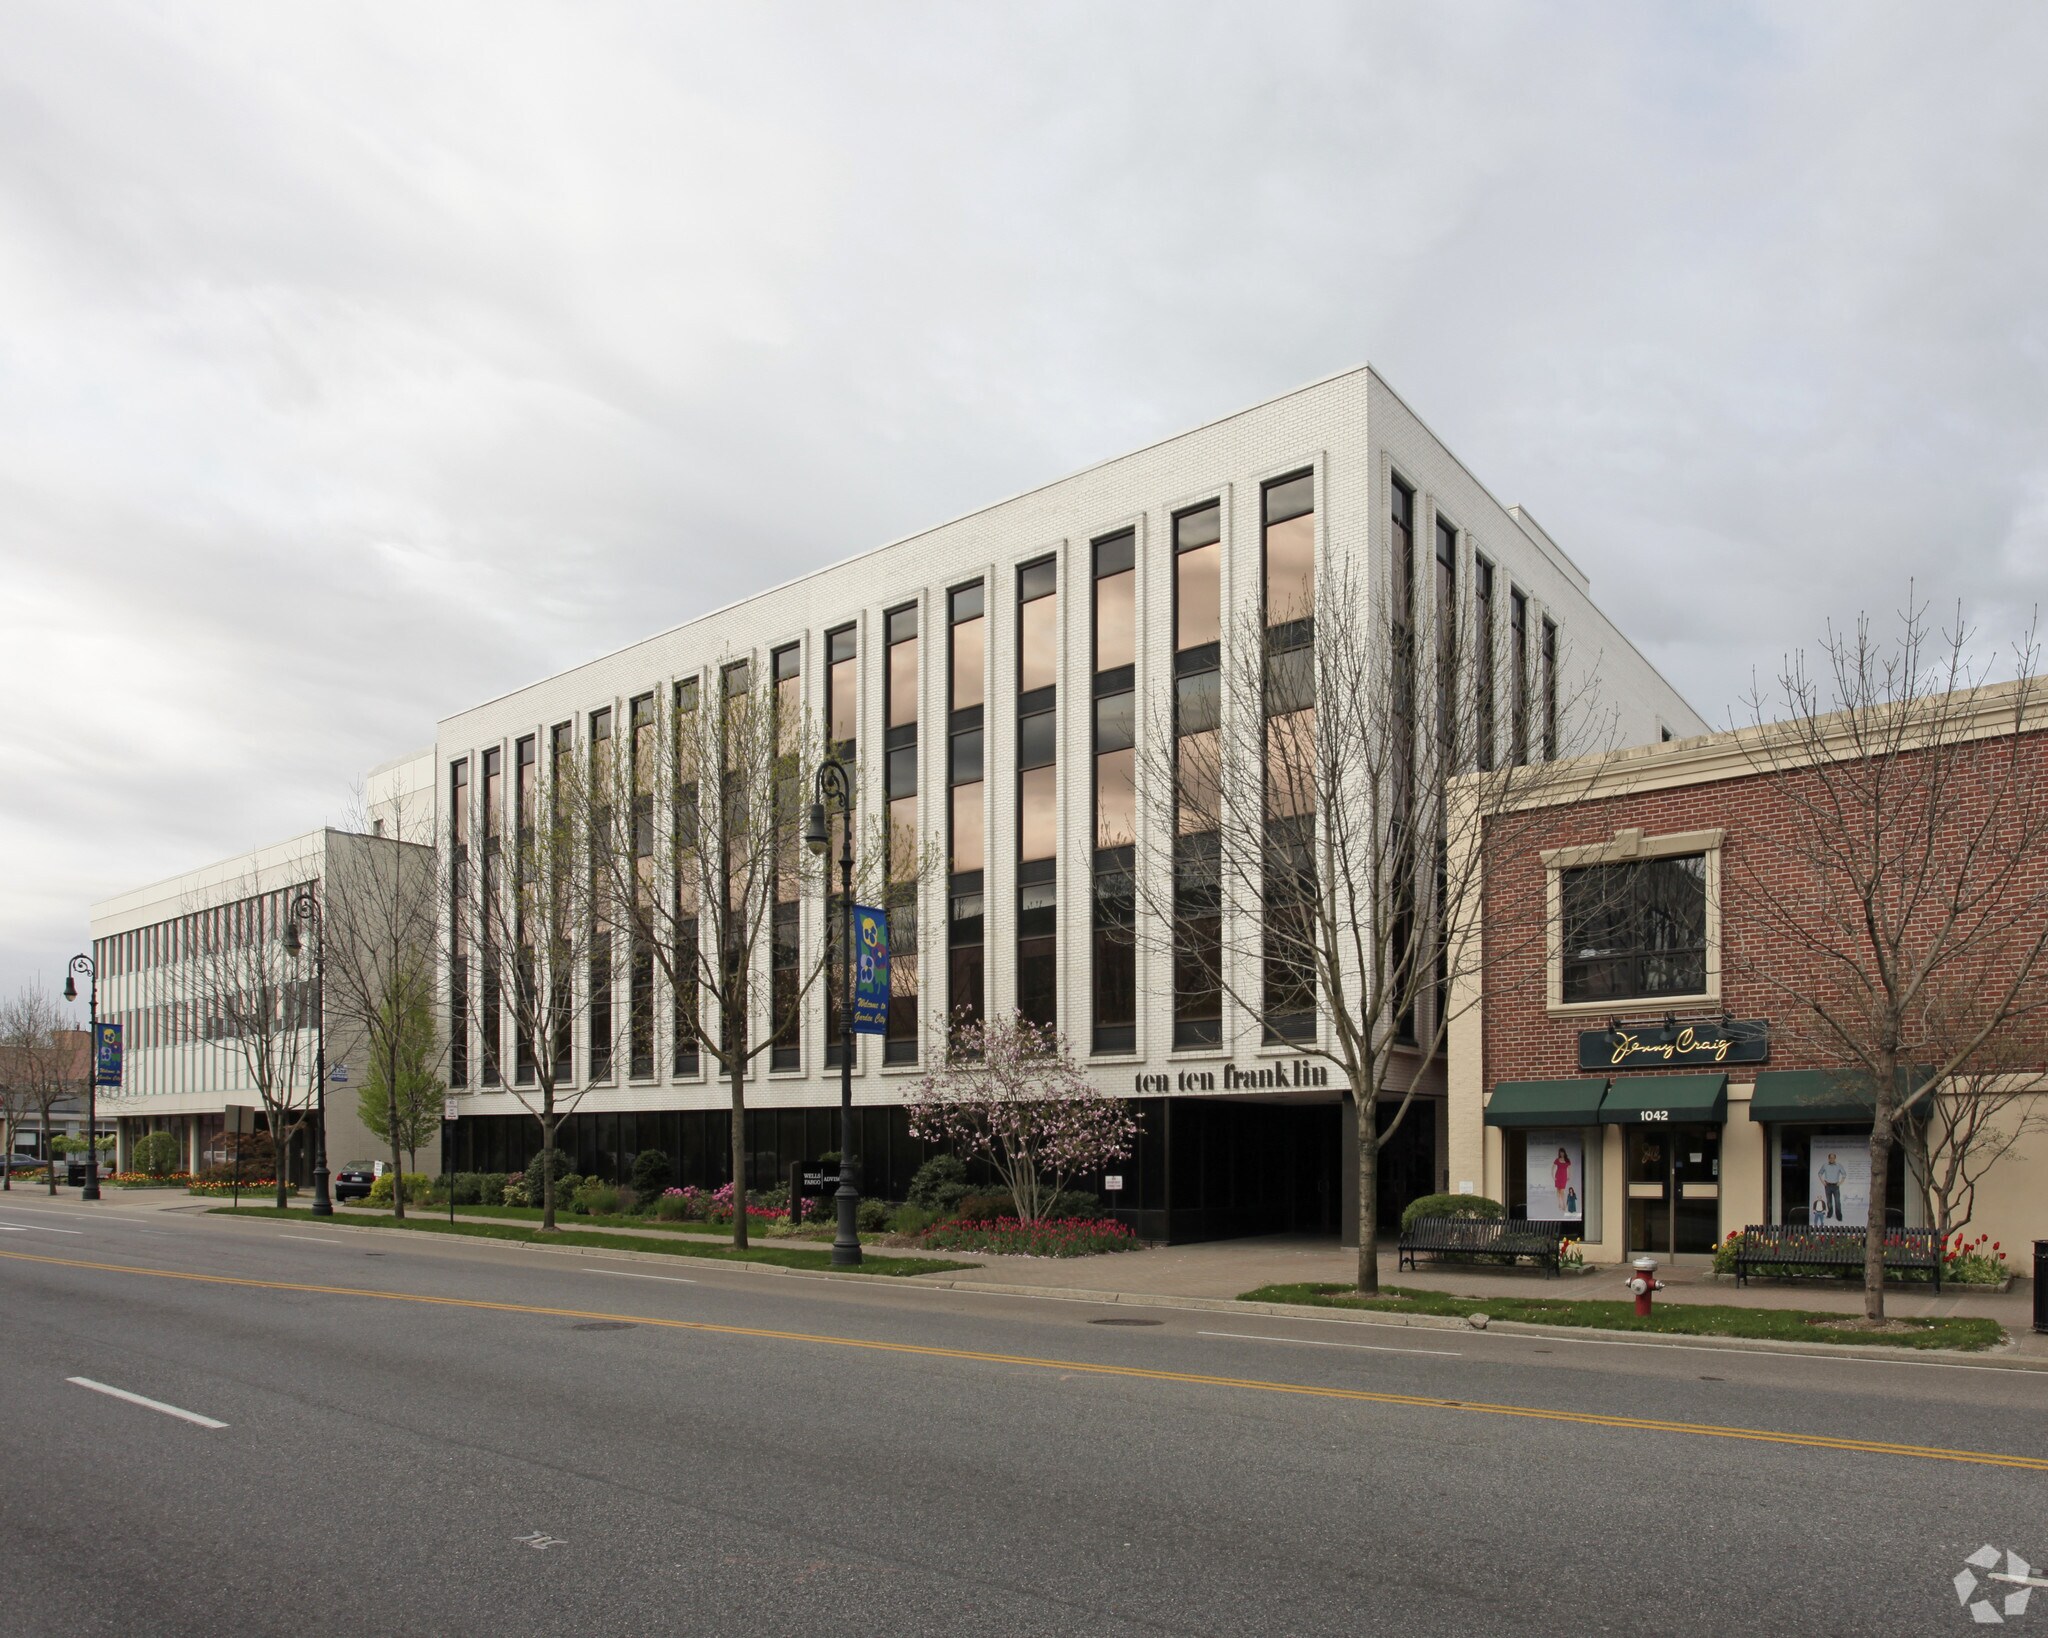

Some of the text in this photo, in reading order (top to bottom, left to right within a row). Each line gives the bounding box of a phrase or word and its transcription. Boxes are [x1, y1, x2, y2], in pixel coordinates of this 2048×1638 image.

[858, 998, 878, 1008] Welcome
[854, 1011, 886, 1024] Garden City
[1611, 1026, 1733, 1064] Jenny Craig
[1135, 1059, 1328, 1093] ten ten franklin
[1640, 1110, 1669, 1121] 1042
